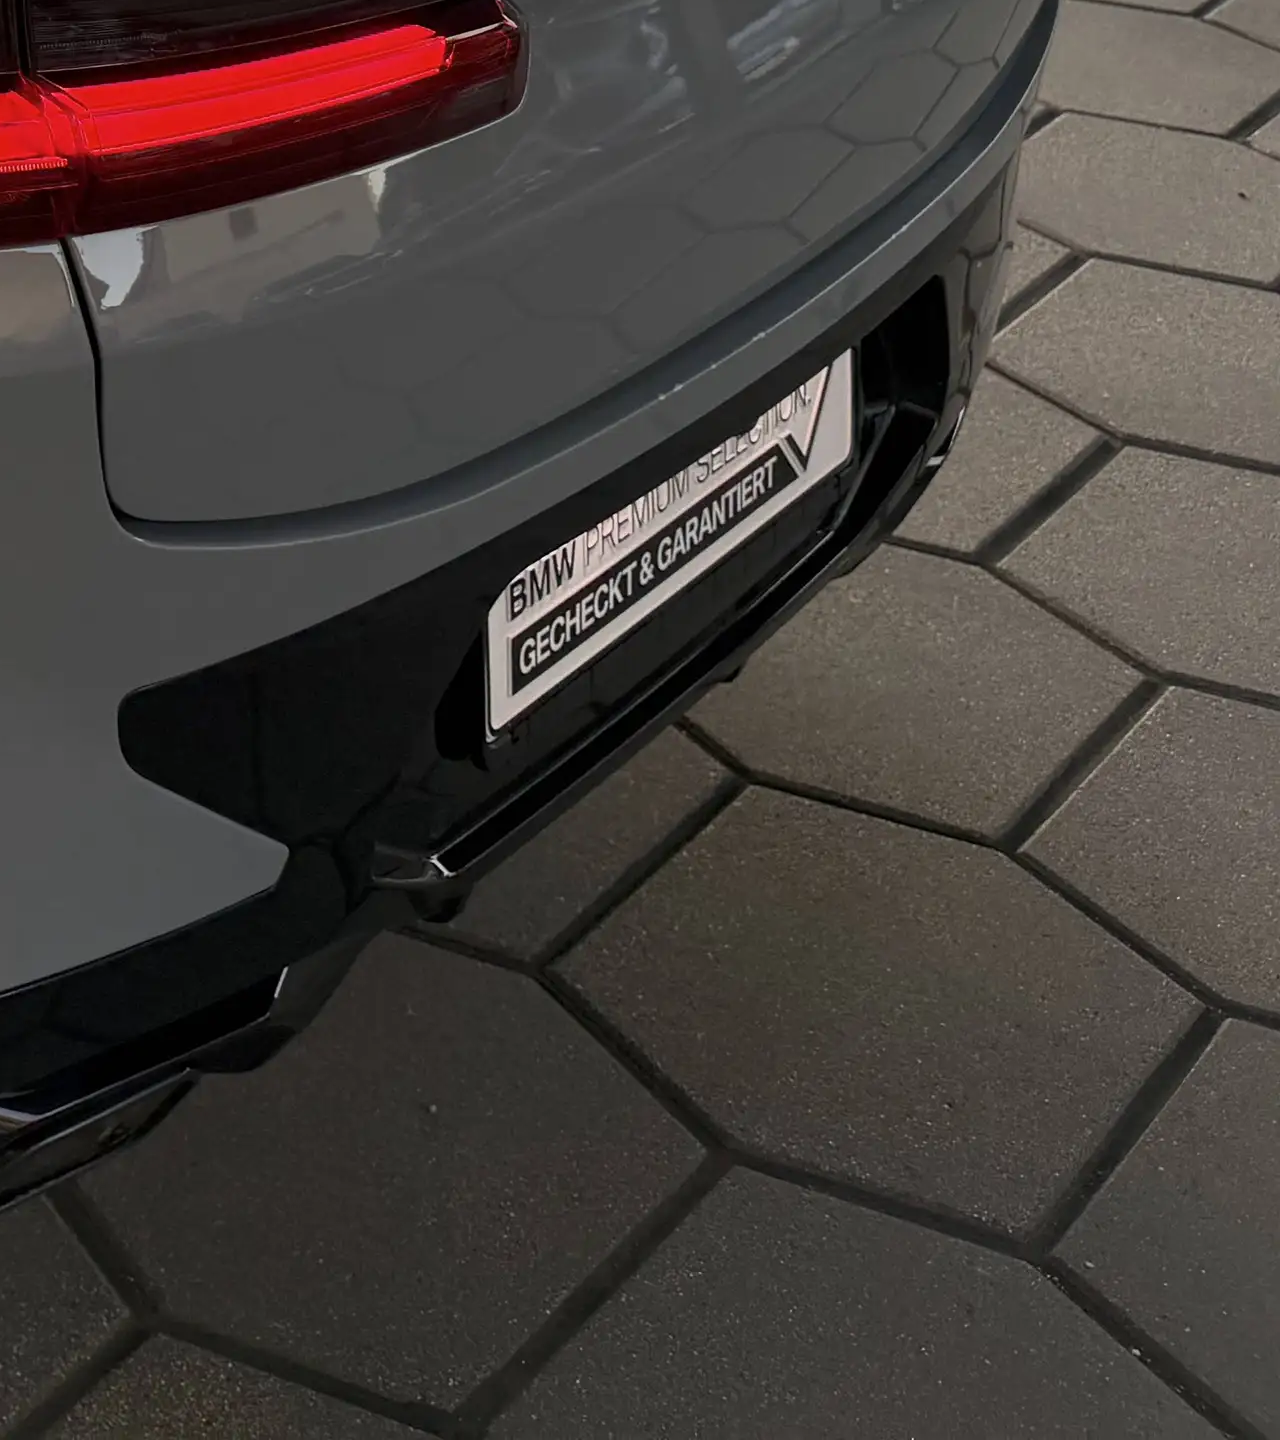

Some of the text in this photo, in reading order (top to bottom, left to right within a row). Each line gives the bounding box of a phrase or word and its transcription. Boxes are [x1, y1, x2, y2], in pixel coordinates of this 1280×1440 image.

[507, 541, 577, 622] BMW
[584, 467, 689, 566] PREMIUM
[519, 456, 778, 675] GECHECKT & GARANTIERT
